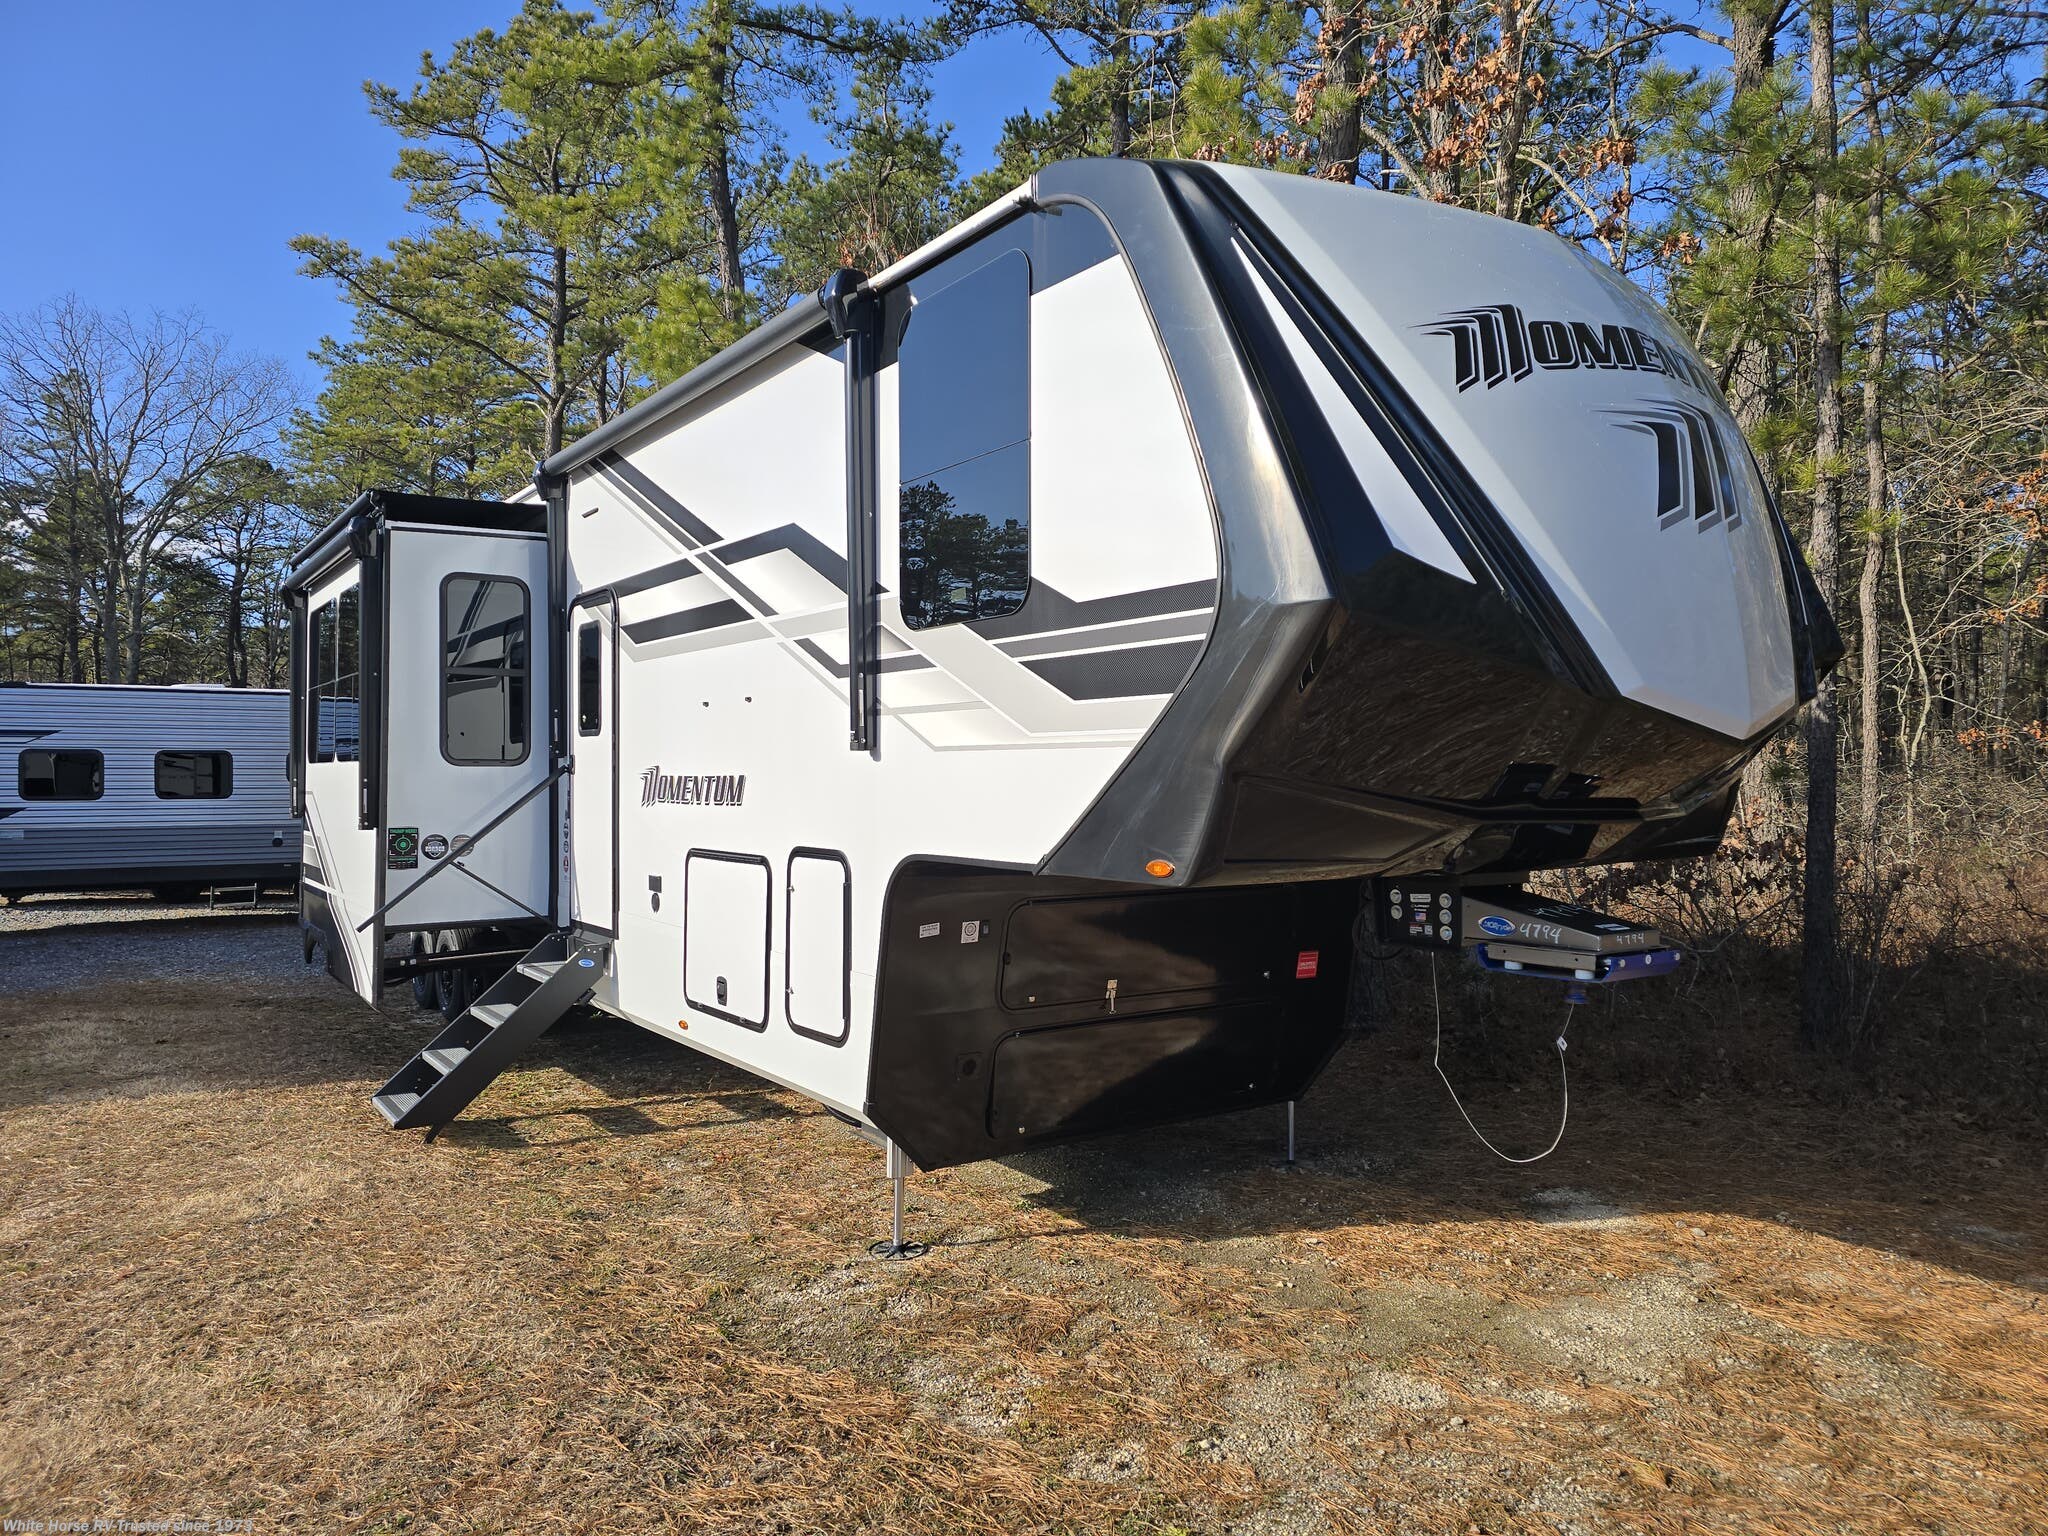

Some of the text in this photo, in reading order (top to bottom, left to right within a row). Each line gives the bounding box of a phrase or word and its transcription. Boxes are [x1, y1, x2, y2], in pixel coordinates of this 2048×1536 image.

[639, 765, 746, 807] MOMENTUM
[1519, 922, 1562, 944] 4794
[1616, 932, 1645, 945] 4794
